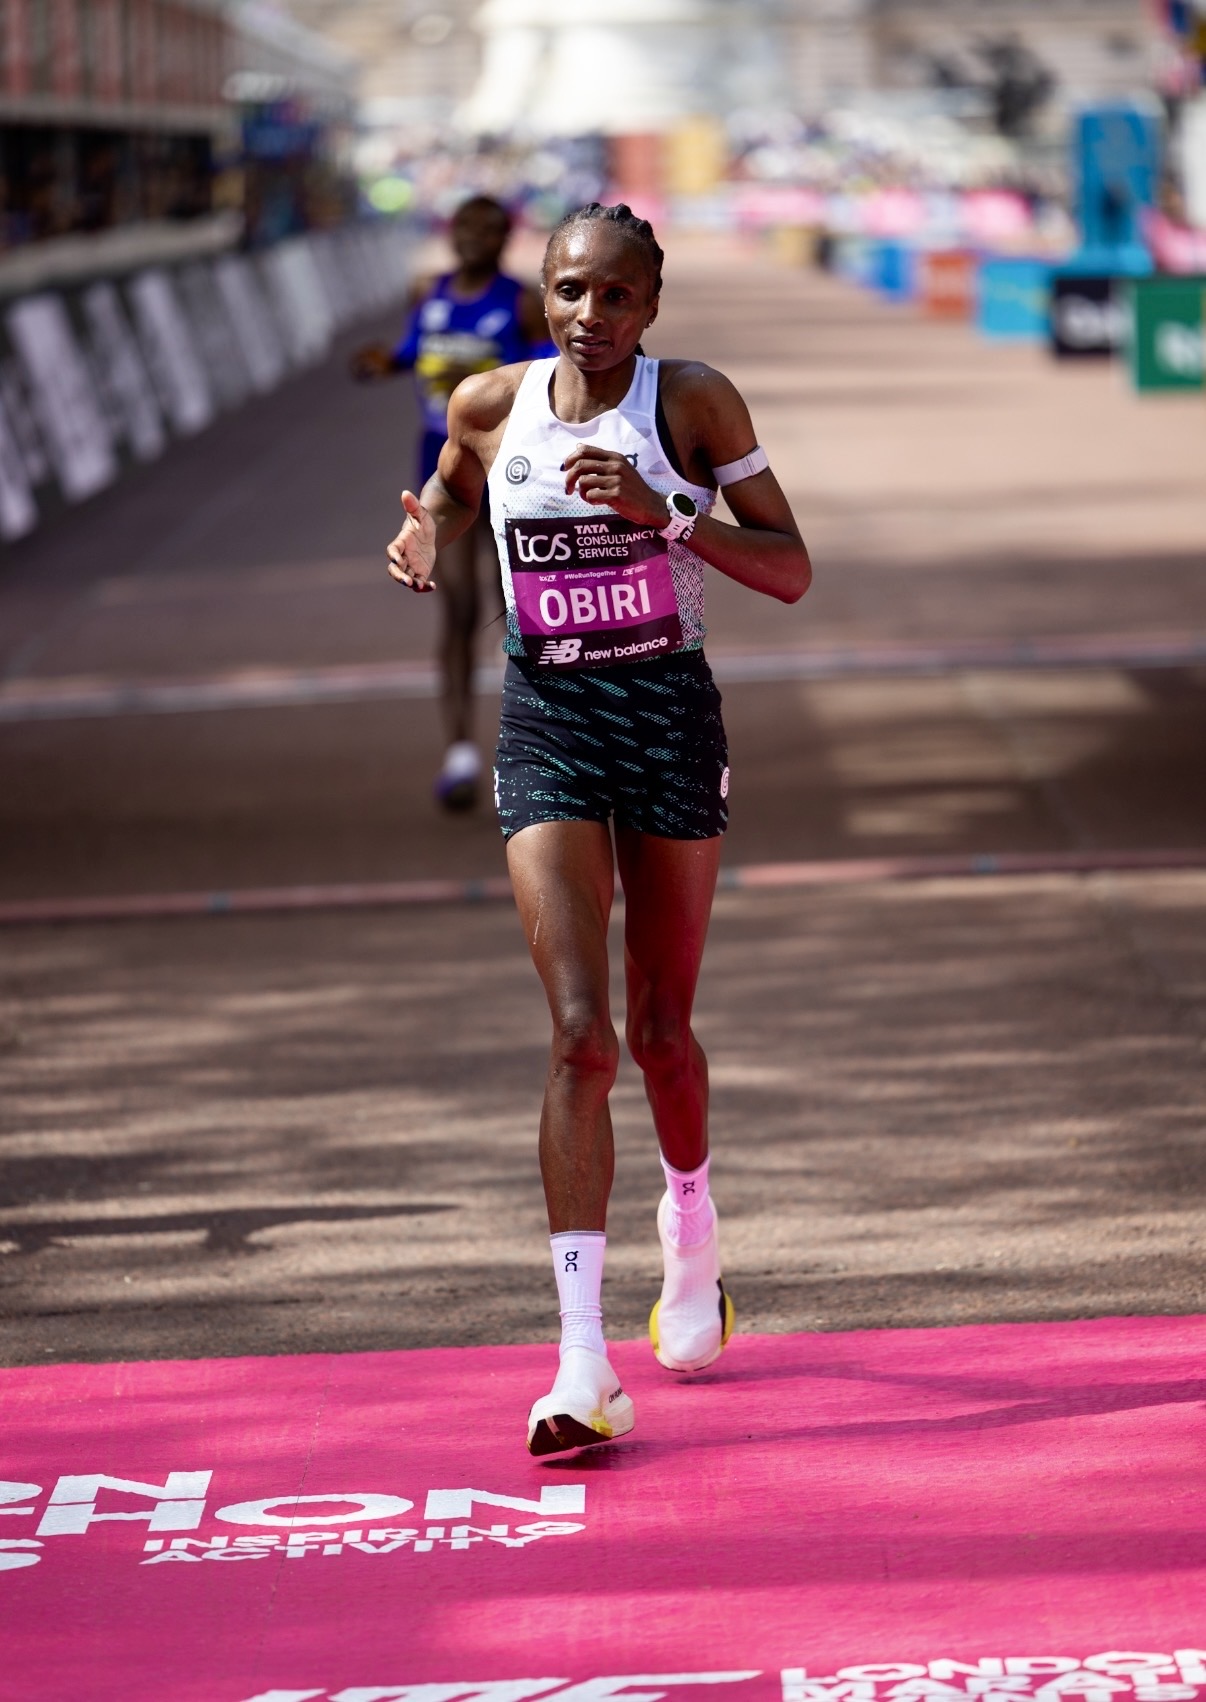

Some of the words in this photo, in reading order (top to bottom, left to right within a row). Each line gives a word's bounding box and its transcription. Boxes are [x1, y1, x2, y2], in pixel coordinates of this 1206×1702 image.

[574, 523, 609, 535] TATA
[576, 529, 656, 547] CONSULTANCY
[514, 528, 572, 563] tcs
[578, 546, 629, 559] SERVICES
[564, 570, 617, 580] #WeRunTogether
[539, 578, 651, 628] OBIRI
[584, 648, 611, 661] new
[614, 636, 668, 657] balance
[143, 1521, 587, 1552] INSPIRING
[139, 1534, 545, 1565] ACTIVITY
